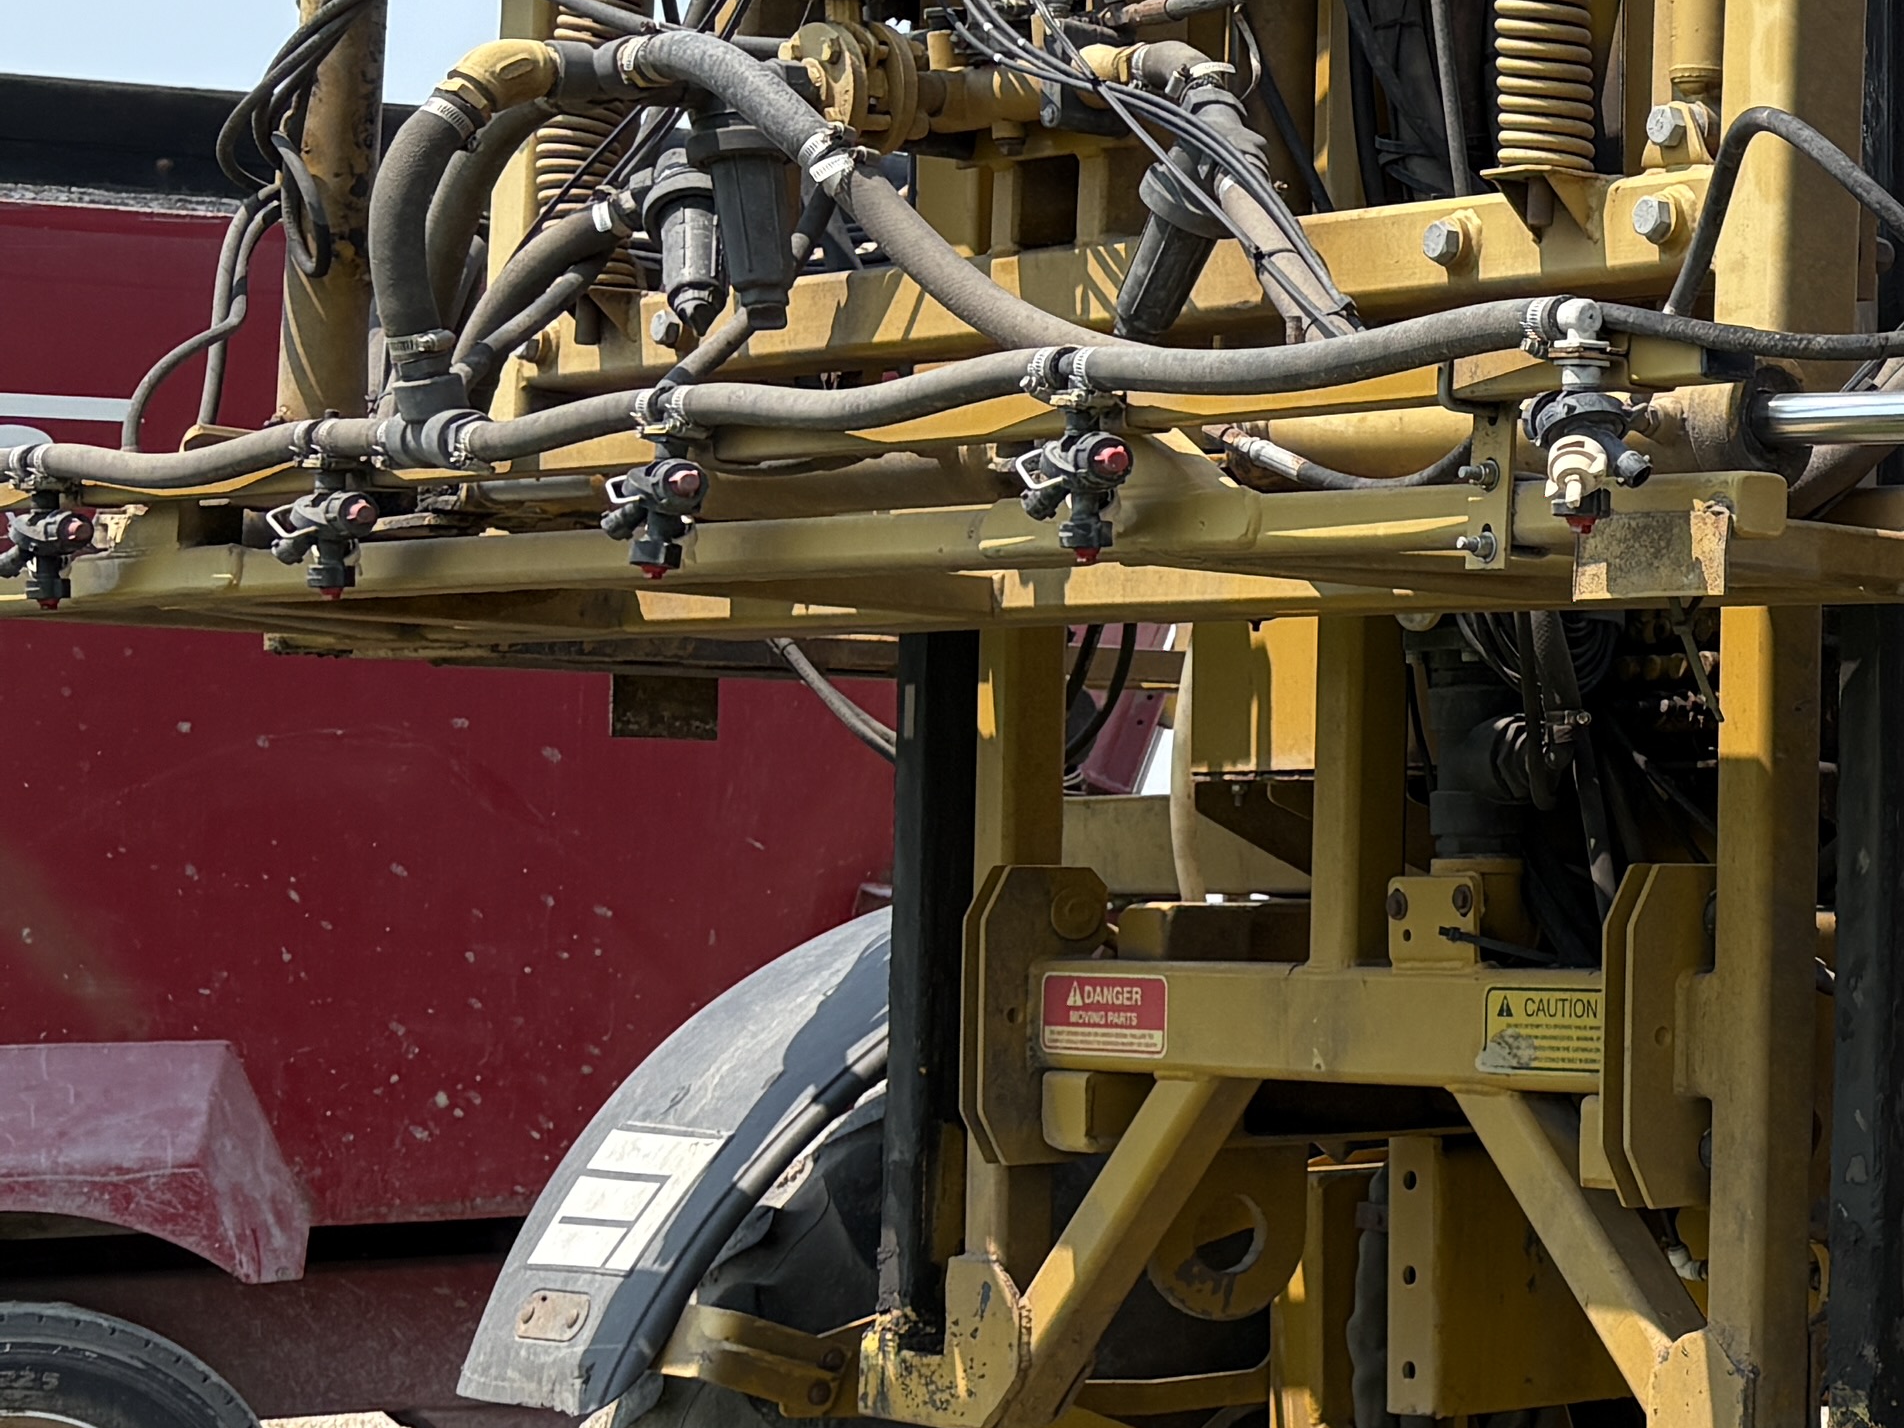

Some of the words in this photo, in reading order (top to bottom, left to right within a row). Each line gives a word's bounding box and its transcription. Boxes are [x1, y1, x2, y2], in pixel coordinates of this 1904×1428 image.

[1084, 985, 1142, 1006] DANGER
[1069, 1010, 1105, 1025] MOVING
[1107, 1011, 1138, 1026] PARTS
[1524, 998, 1598, 1019] CAUTION
